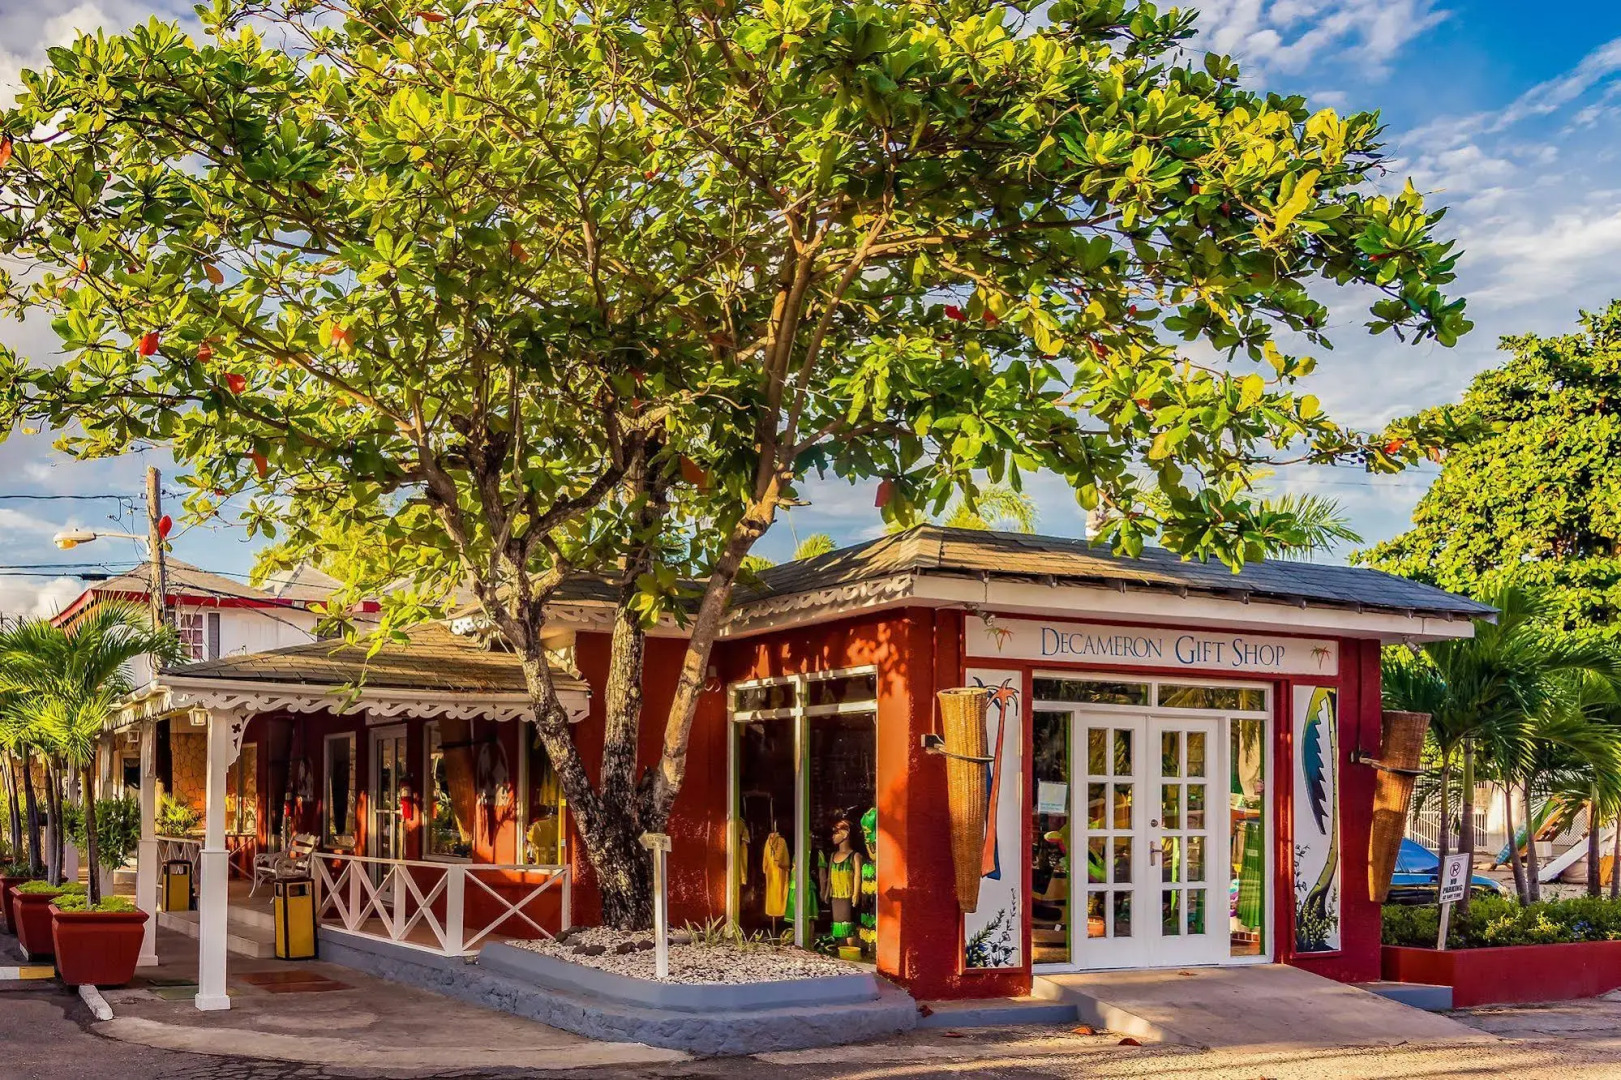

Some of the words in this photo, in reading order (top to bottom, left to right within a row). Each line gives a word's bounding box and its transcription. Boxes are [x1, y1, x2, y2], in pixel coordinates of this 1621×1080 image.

[1041, 627, 1163, 658] DECAMERON
[1175, 635, 1225, 665] GIFT
[1231, 638, 1286, 668] SHOP
[1450, 878, 1457, 886] NO
[1442, 885, 1463, 894] PARKING
